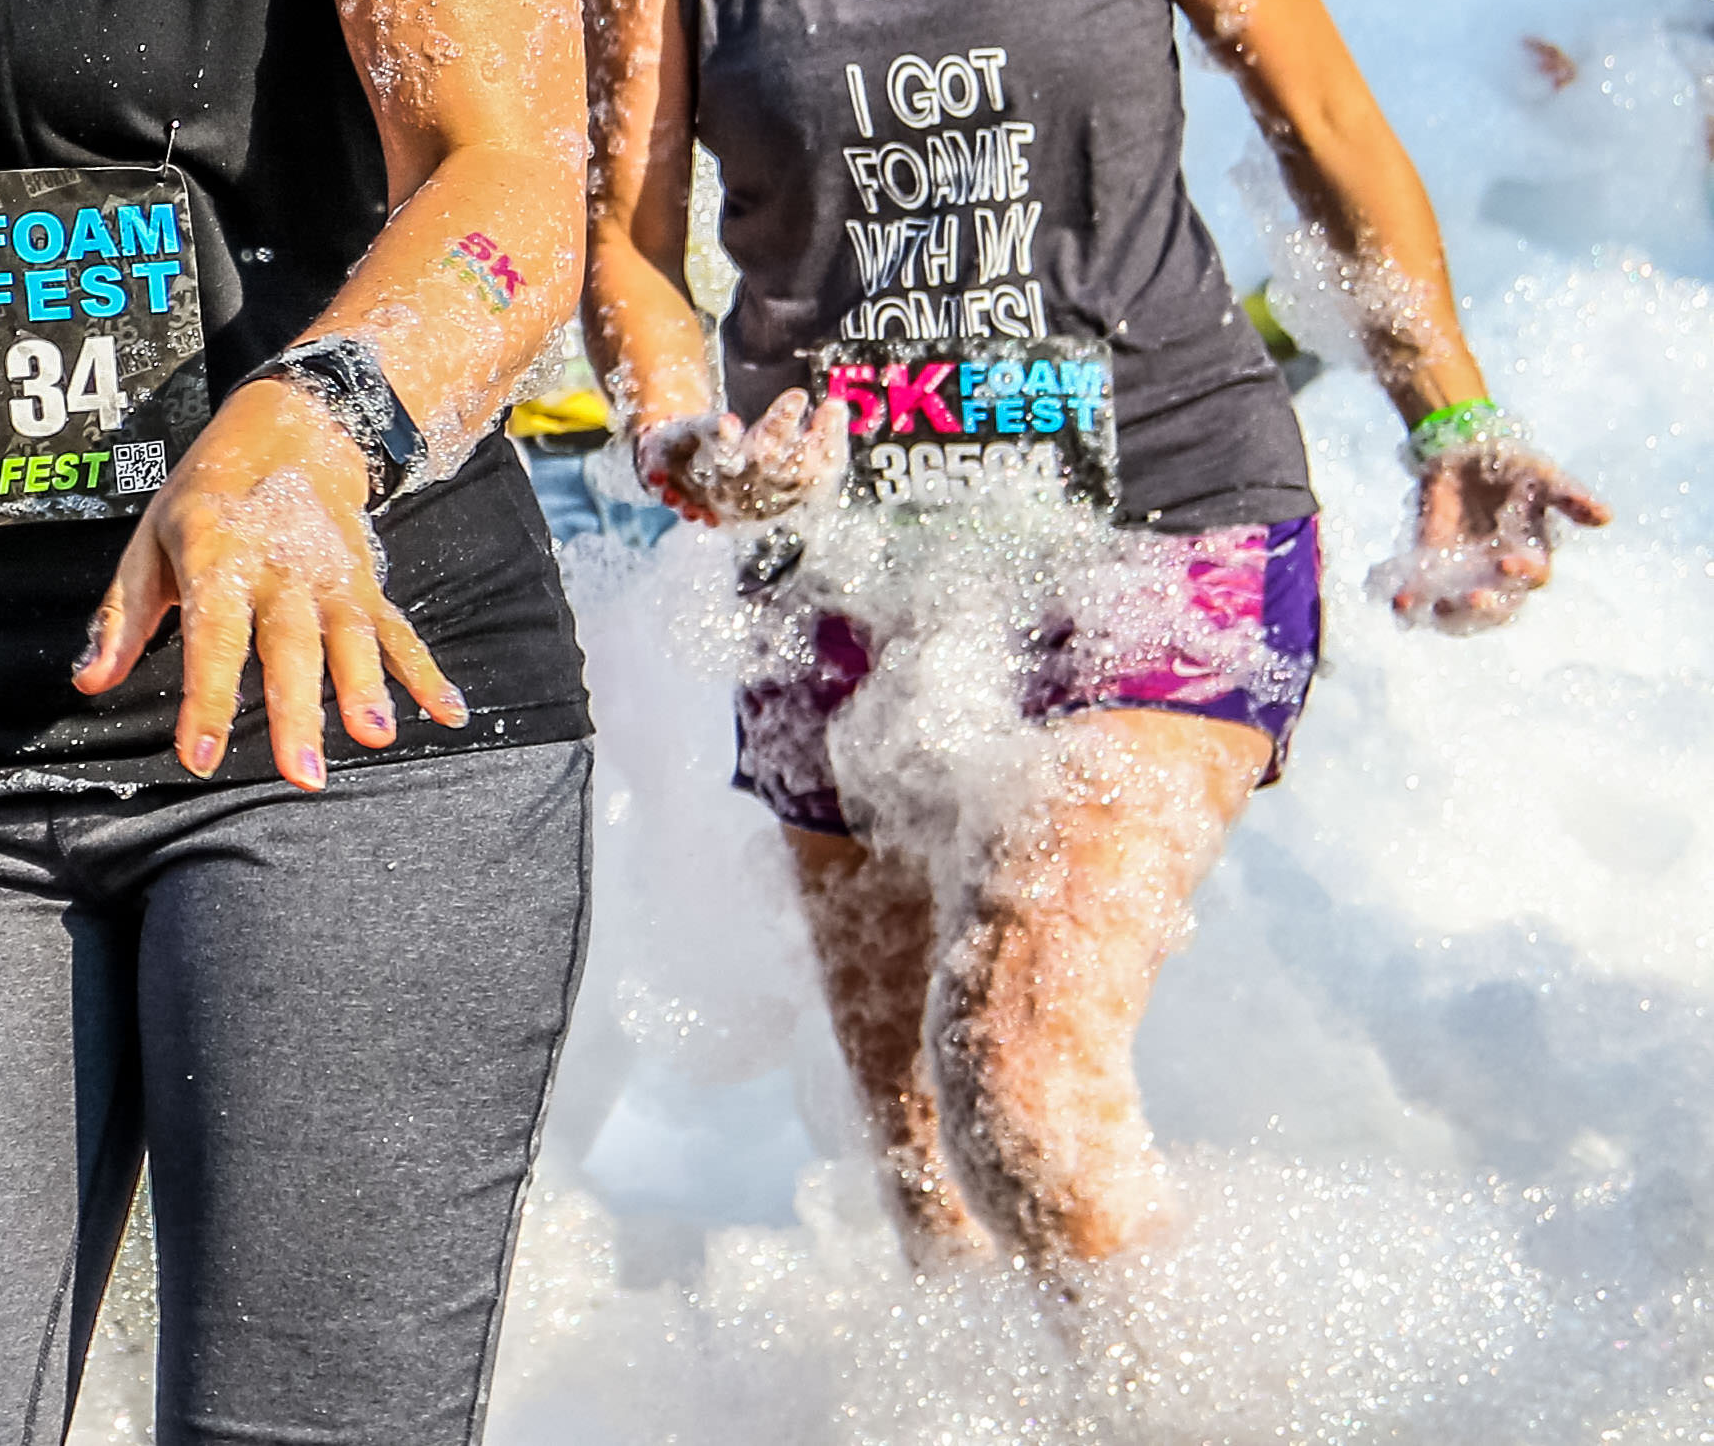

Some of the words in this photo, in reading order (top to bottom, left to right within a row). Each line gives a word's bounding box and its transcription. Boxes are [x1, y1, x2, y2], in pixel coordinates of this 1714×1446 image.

[845, 63, 873, 138] I
[886, 47, 1007, 130] GOT
[458, 232, 528, 298] 5K
[974, 201, 1043, 285] MY
[828, 361, 963, 435] 5K
[959, 359, 1105, 397] FOAM
[961, 398, 1102, 435] FEST
